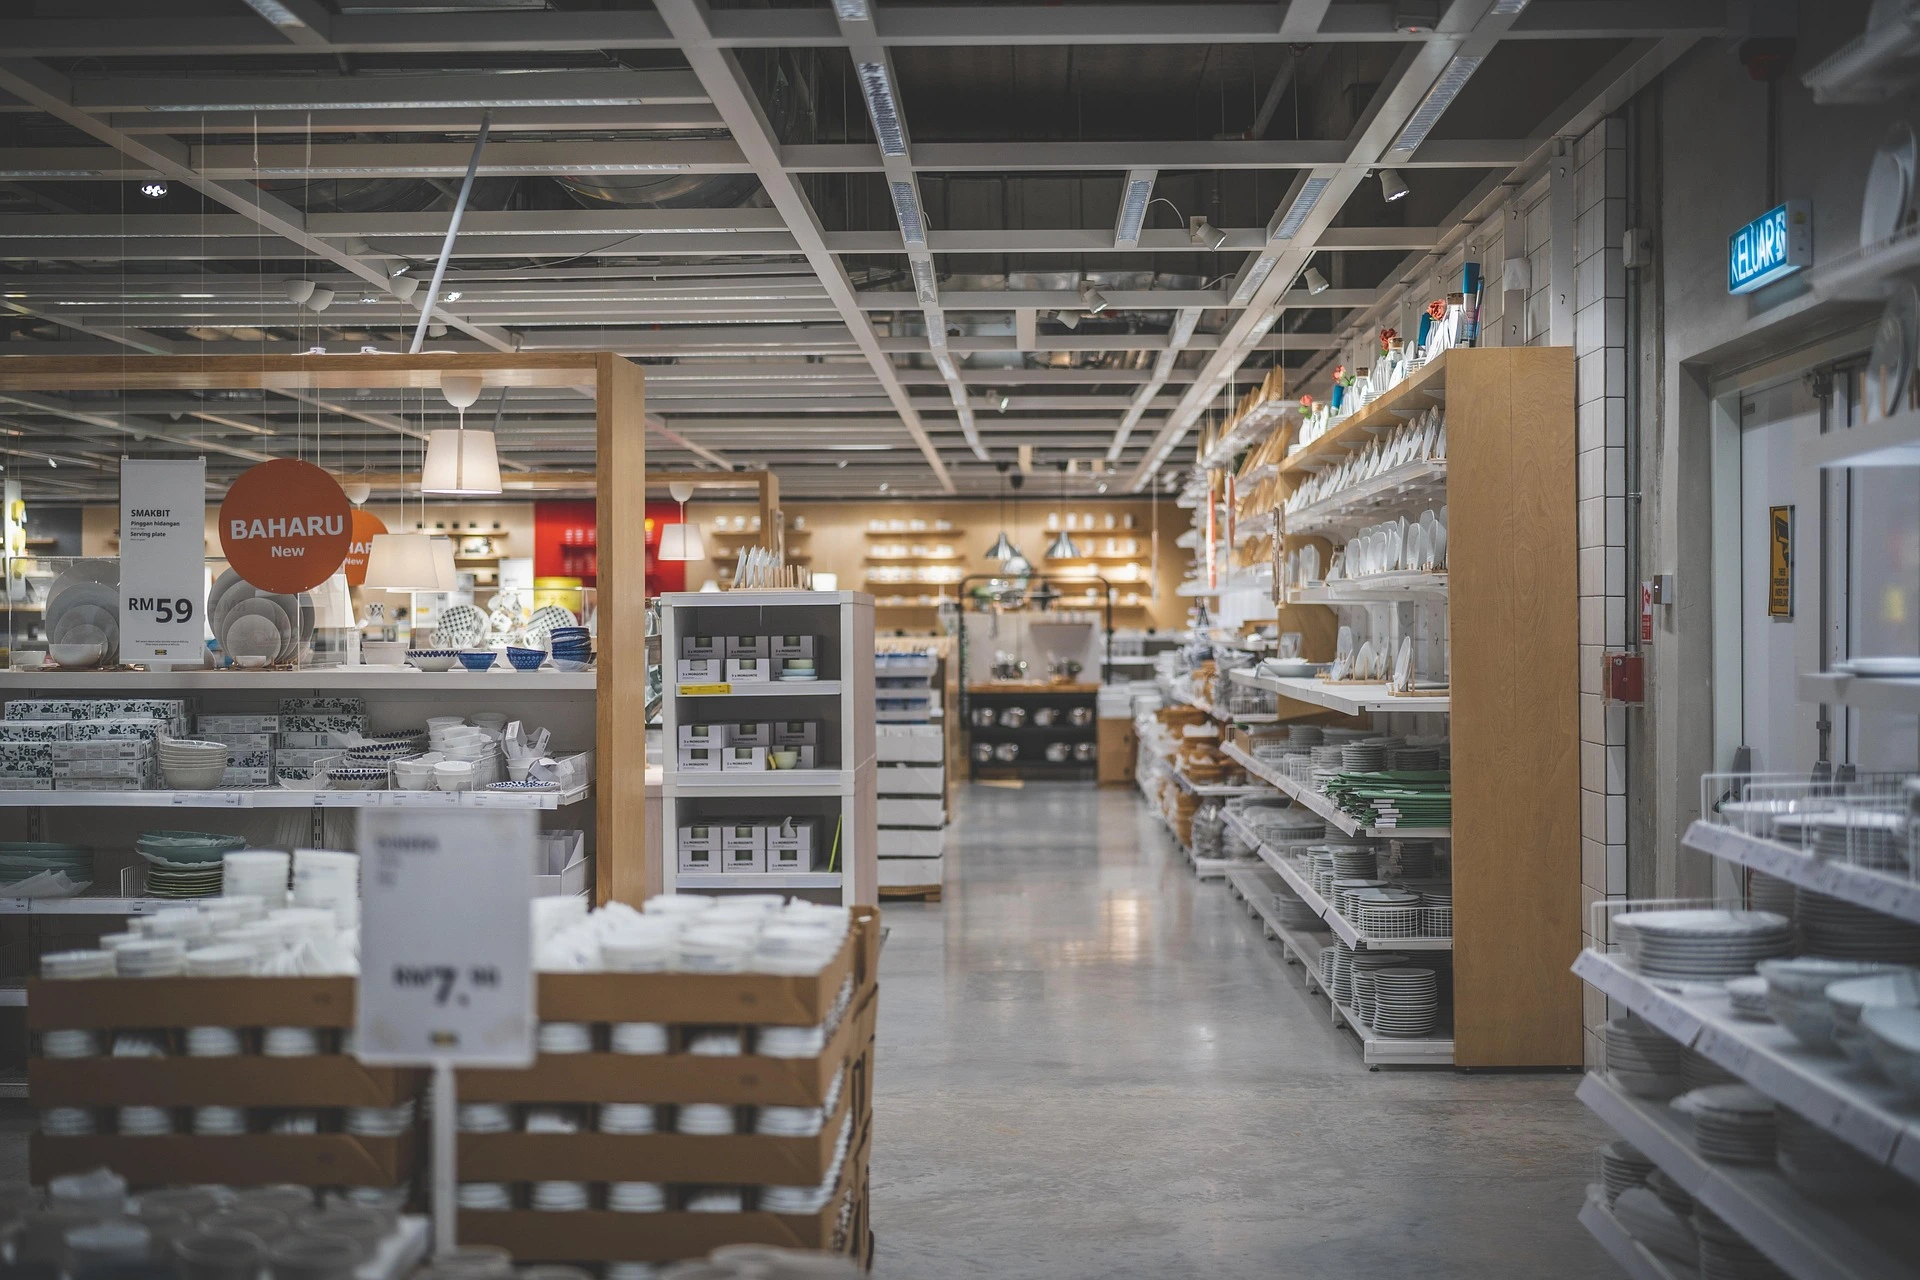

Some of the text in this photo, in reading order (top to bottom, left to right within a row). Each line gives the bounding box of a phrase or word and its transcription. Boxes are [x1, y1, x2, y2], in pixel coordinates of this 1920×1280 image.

[1731, 218, 1775, 285] KELUAR
[130, 509, 171, 518] SMAKBIT
[130, 520, 180, 528] Pinggan hidangan
[230, 514, 344, 540] BAHARU
[271, 545, 305, 558] New
